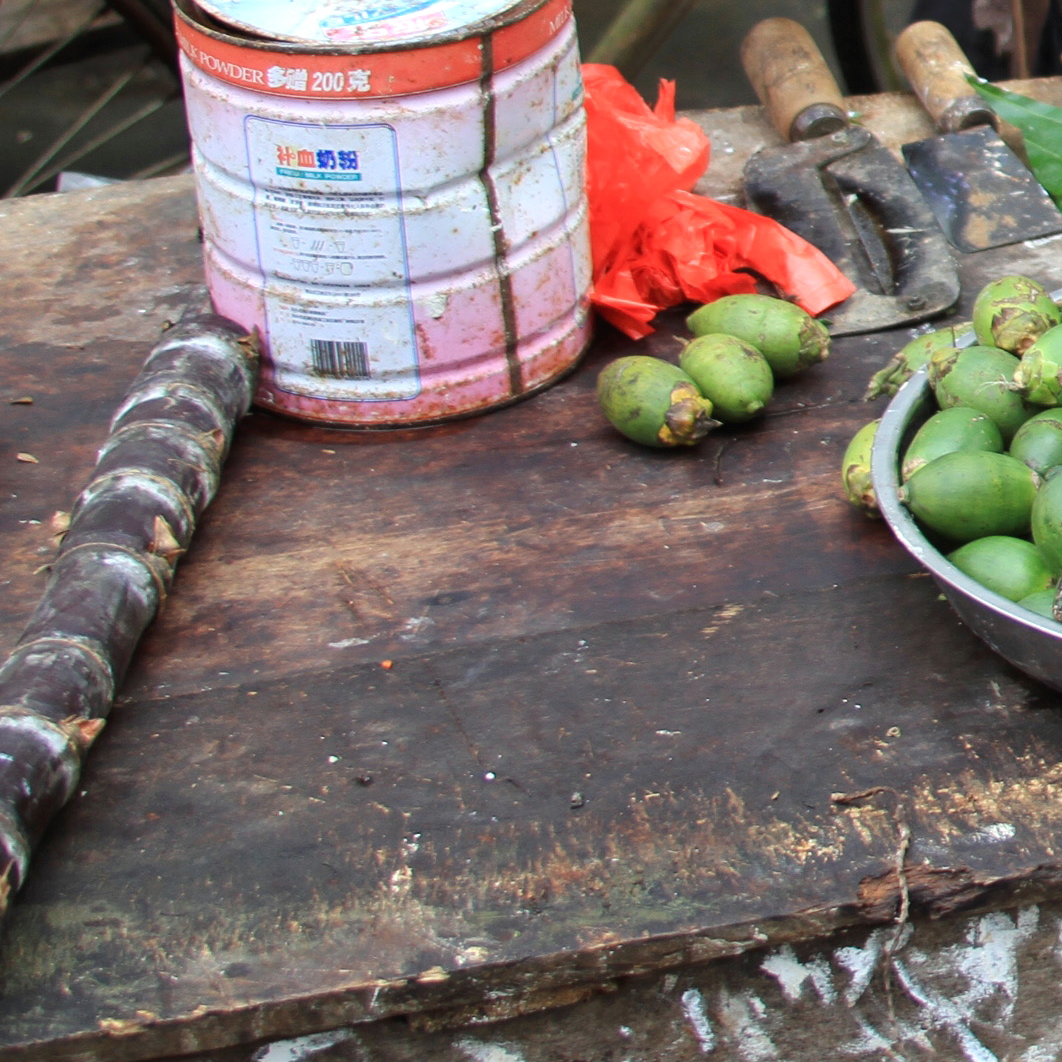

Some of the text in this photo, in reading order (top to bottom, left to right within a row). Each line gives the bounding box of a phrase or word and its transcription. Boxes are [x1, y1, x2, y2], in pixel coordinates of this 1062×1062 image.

[199, 51, 264, 84] POWDER
[311, 71, 344, 92] 200
[346, 69, 371, 92] 克
[276, 145, 358, 170] 补血奶粉
